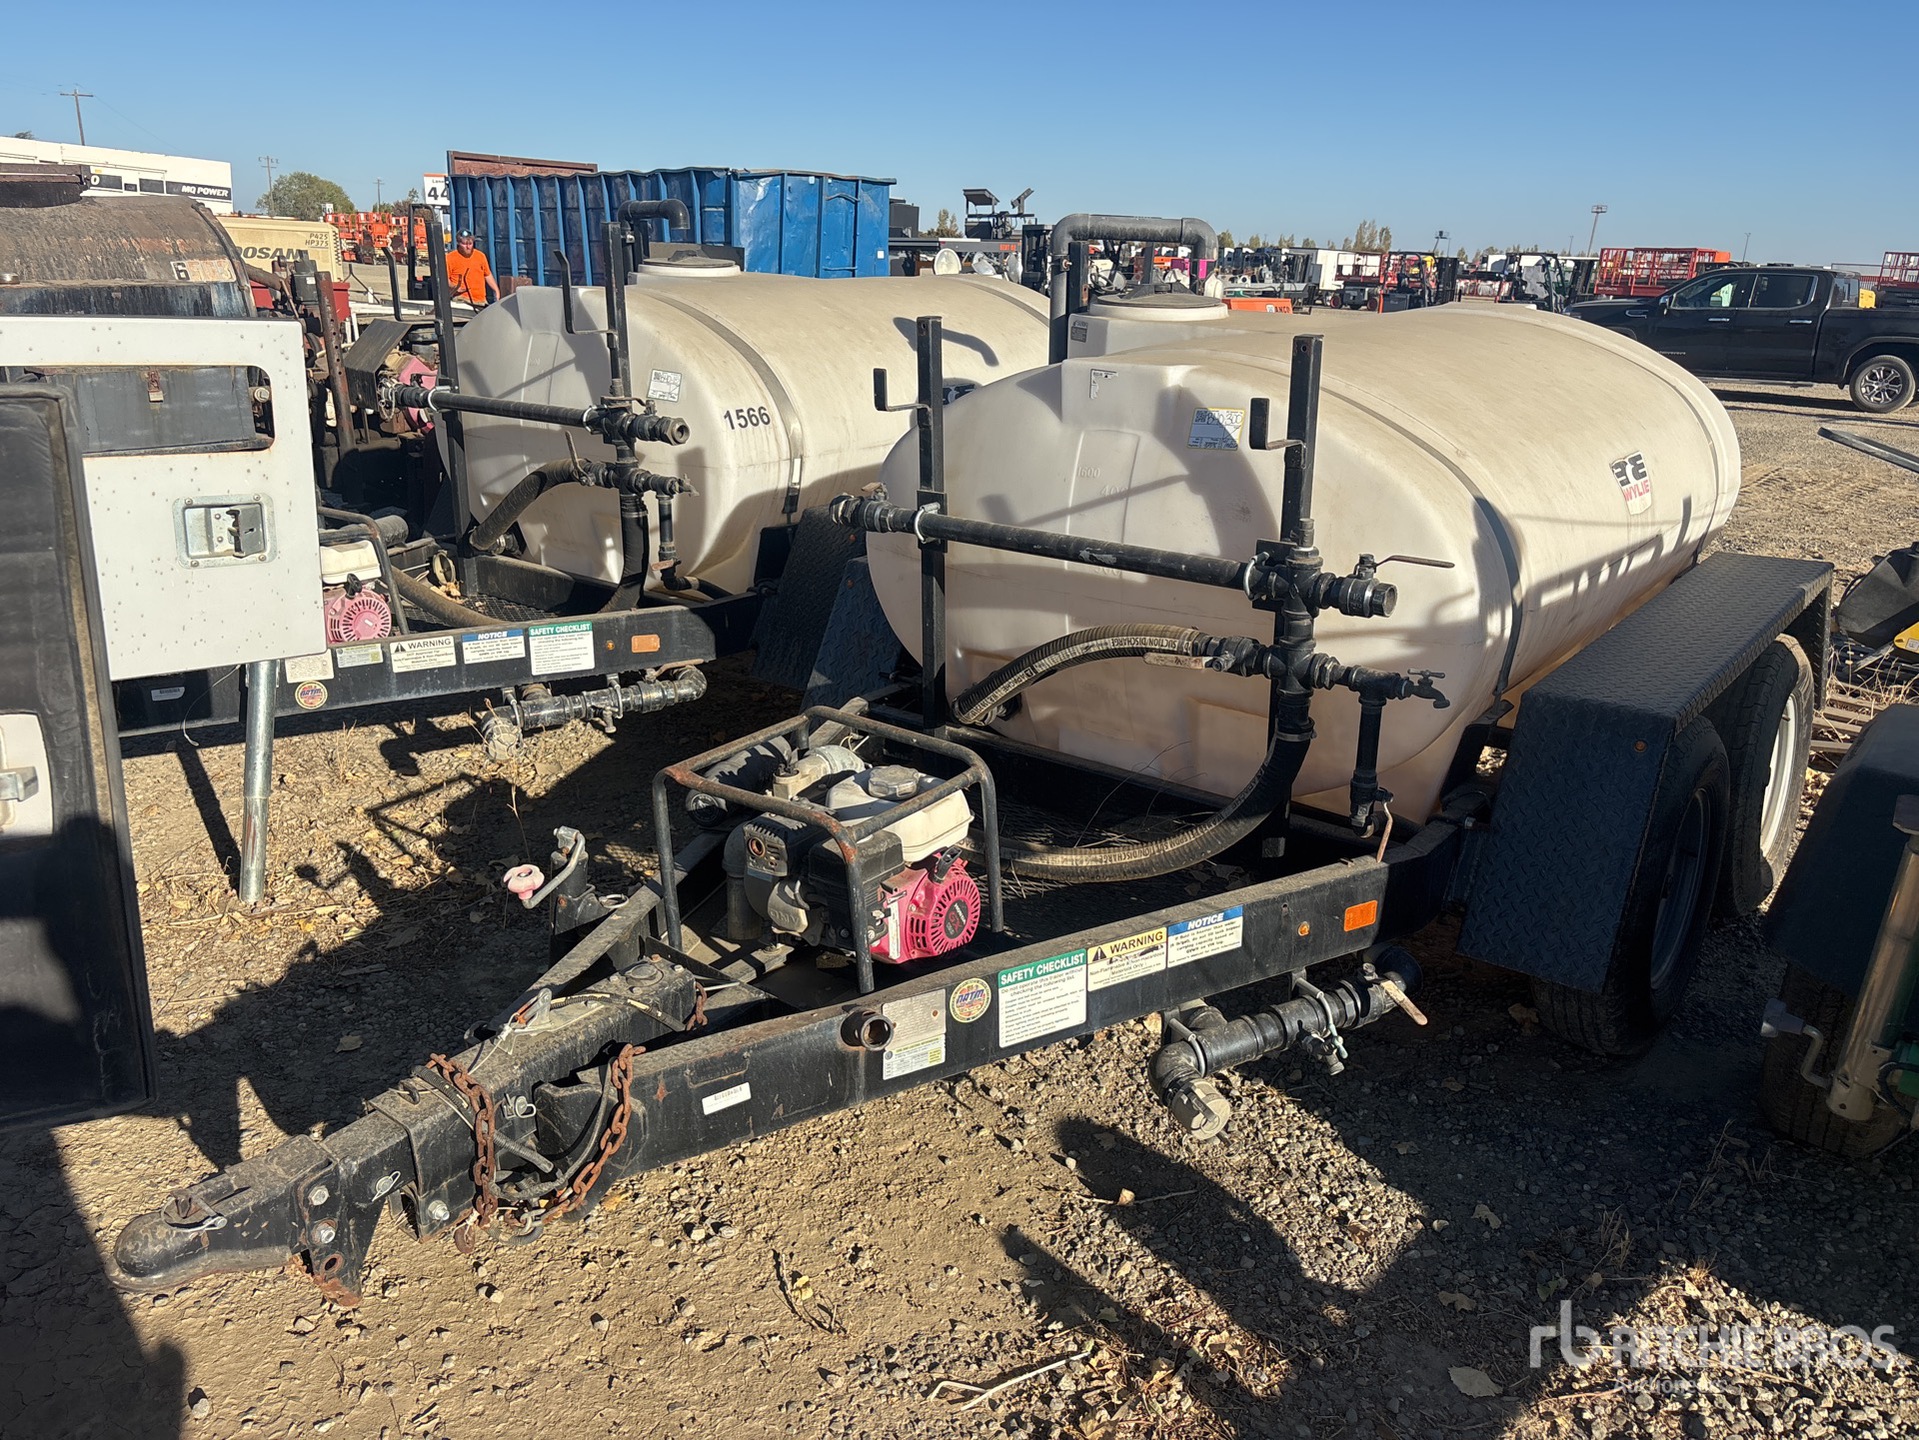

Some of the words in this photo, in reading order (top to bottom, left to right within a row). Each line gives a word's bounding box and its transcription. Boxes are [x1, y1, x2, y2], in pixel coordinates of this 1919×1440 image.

[181, 184, 196, 195] MQ
[197, 186, 229, 197] POWER
[309, 232, 328, 240] P425
[305, 239, 329, 247] HP375
[724, 406, 771, 430] 1566
[1623, 479, 1650, 501] WYLIE
[478, 631, 508, 640] NOTICE
[530, 627, 554, 636] SAFETY
[555, 623, 591, 633] CHECKLIST
[408, 638, 451, 649] WARNING
[1187, 912, 1225, 931] NOTICE
[1110, 931, 1163, 954] WARNING
[1000, 966, 1035, 985] SAFETY
[1036, 953, 1085, 975] CHECKLIST
